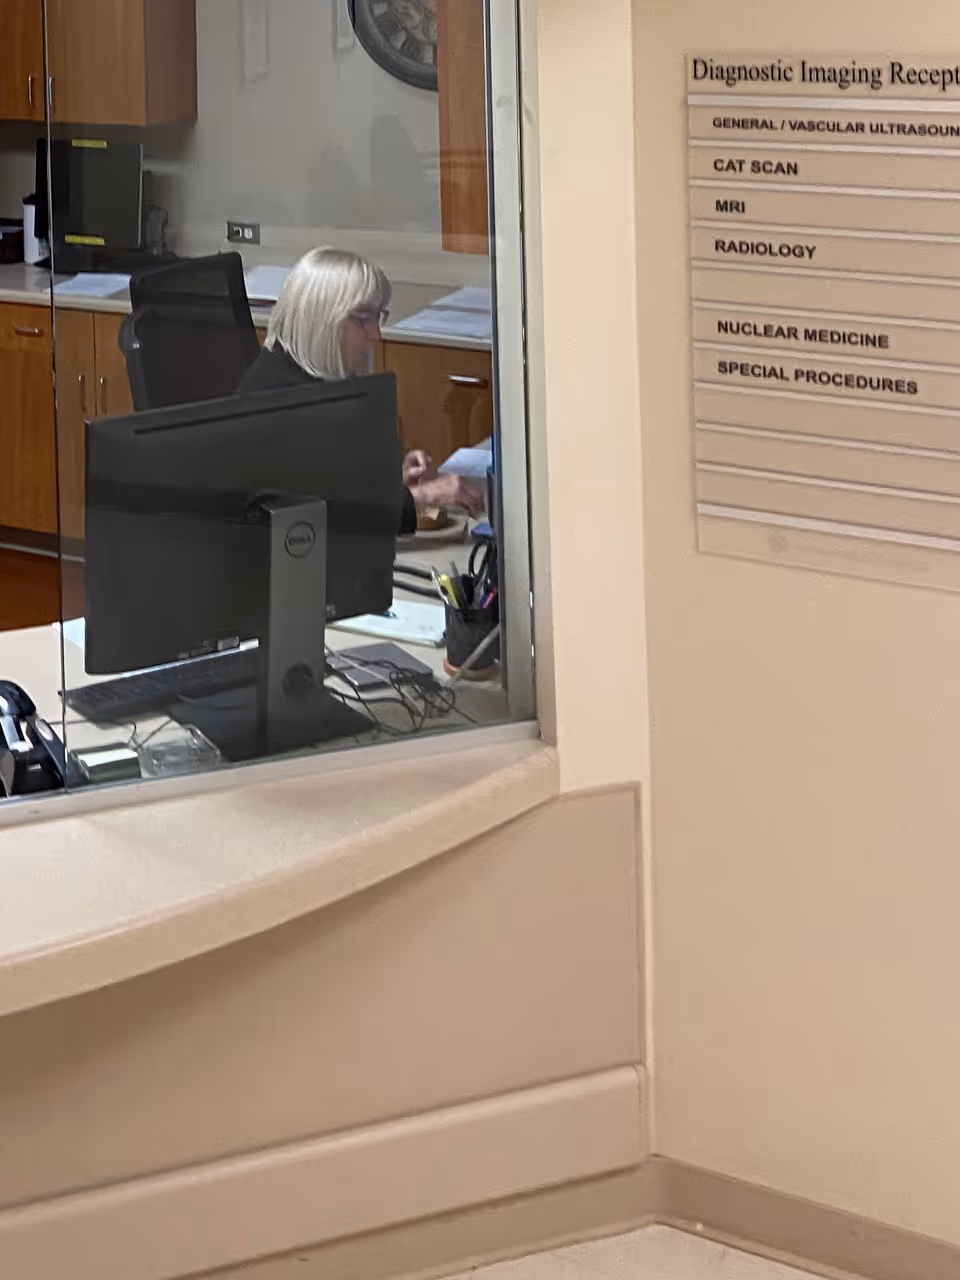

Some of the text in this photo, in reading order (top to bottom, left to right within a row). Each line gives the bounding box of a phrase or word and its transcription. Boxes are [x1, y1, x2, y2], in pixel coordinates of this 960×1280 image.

[692, 57, 793, 86] Diagnostic
[800, 59, 883, 91] Imaging
[712, 116, 776, 131] GENERAL
[789, 119, 865, 134] VASCULAR
[713, 158, 798, 176] CAT SCAN
[715, 199, 745, 213] MRI
[714, 239, 816, 259] RADIOLOGY
[717, 320, 889, 349] NUCLEAR MEDICINE
[717, 360, 918, 395] SPECIAL PROCEDURES
